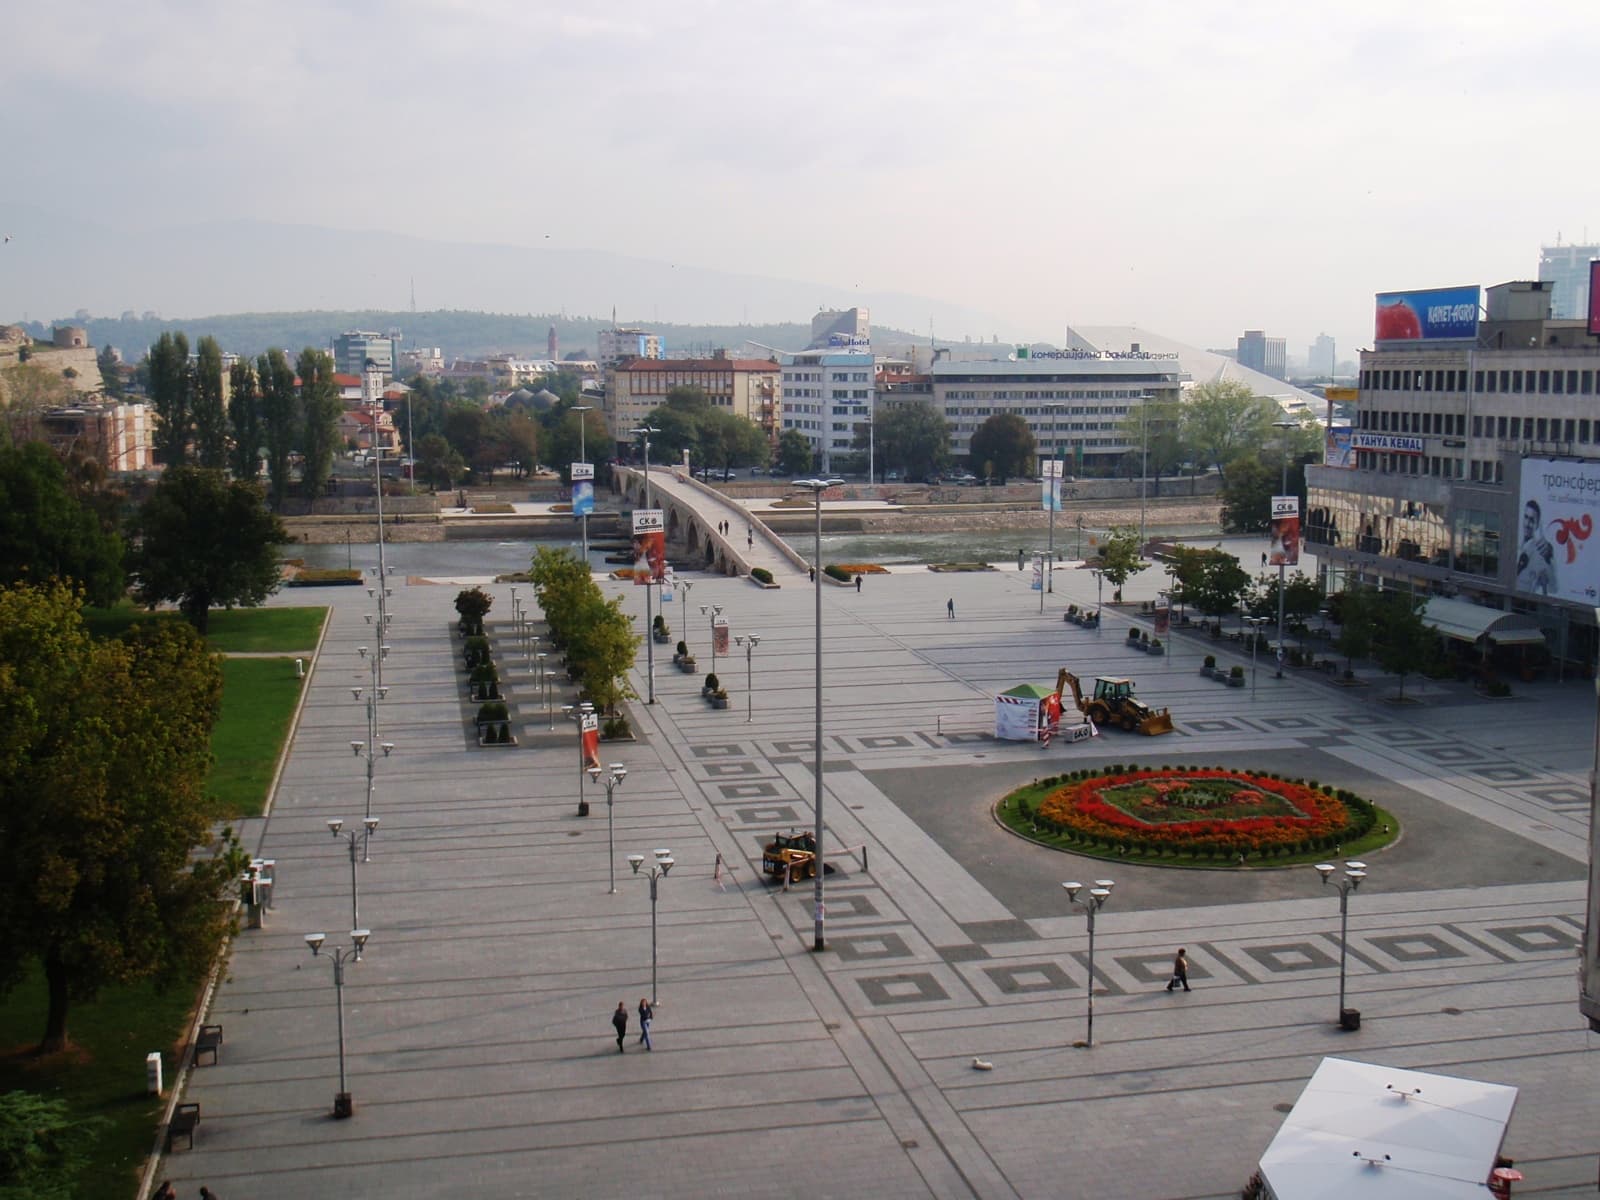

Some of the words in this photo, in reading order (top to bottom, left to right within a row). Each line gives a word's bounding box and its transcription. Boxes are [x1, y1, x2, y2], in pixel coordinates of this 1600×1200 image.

[848, 338, 870, 346] Hotel
[1360, 435, 1388, 448] YAHYA
[1390, 437, 1421, 450] KEMAL
